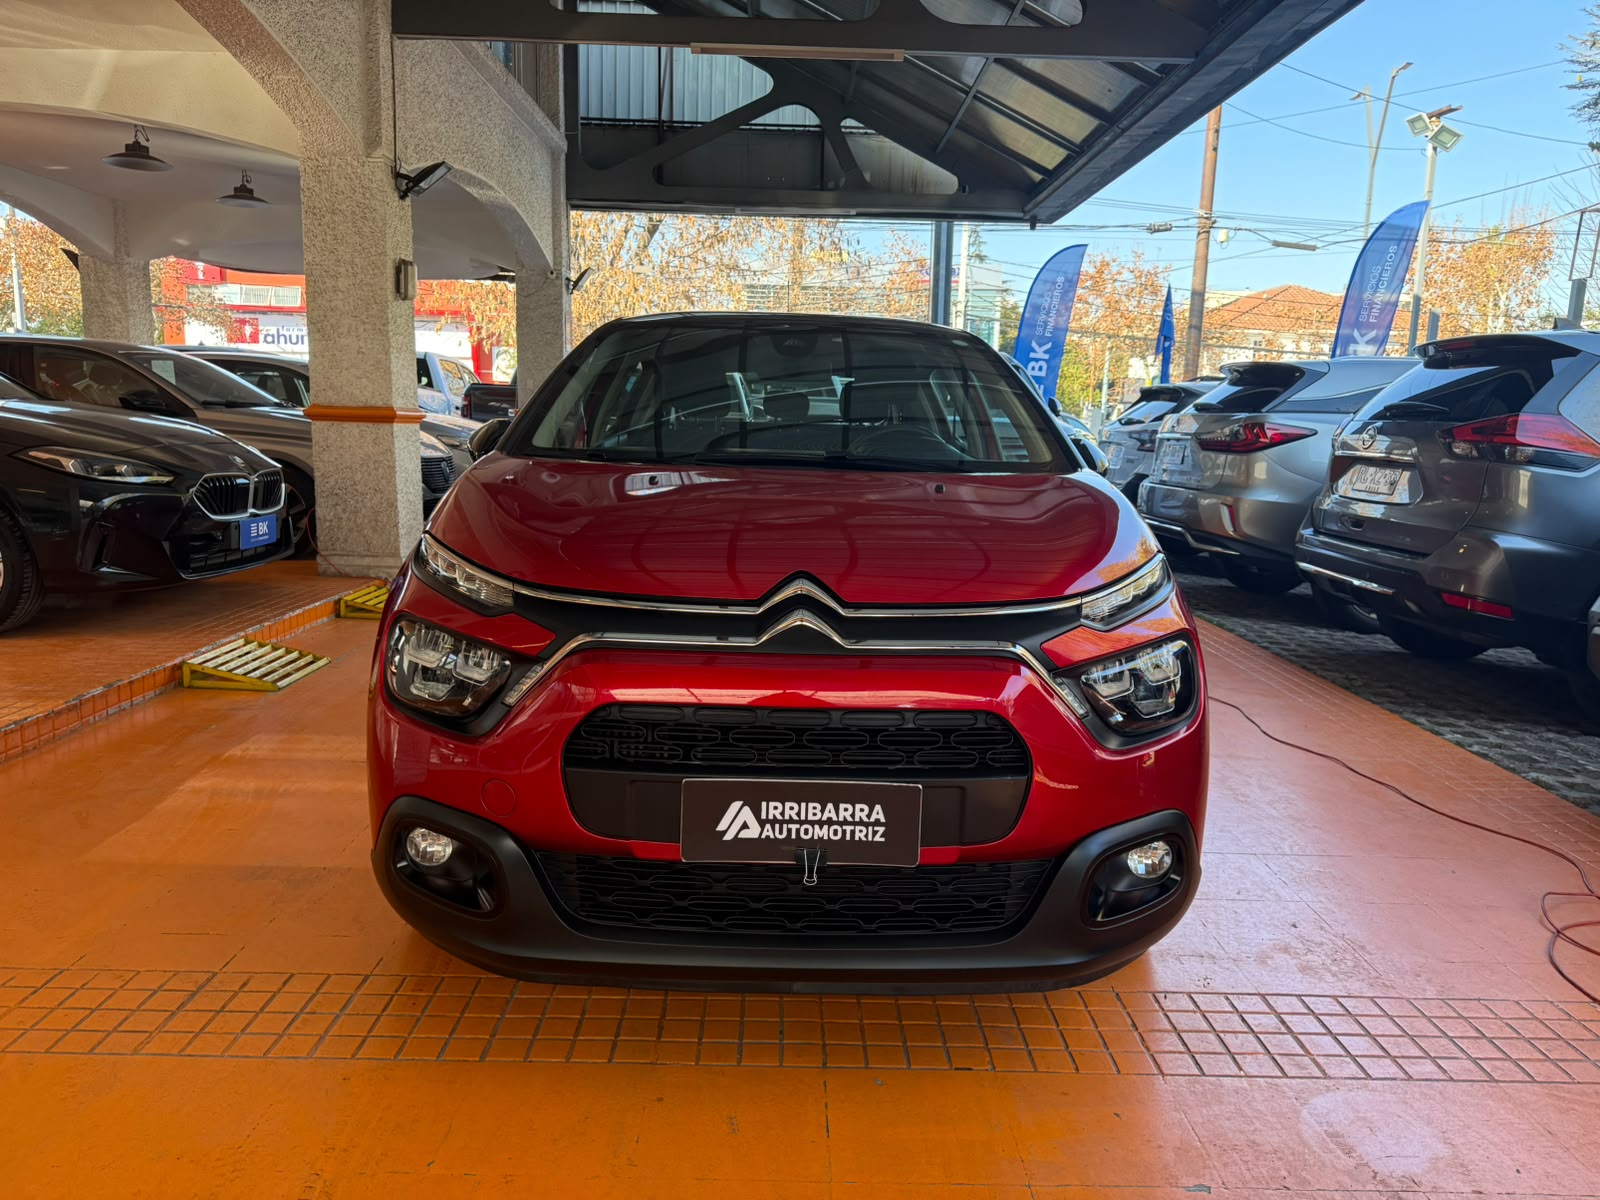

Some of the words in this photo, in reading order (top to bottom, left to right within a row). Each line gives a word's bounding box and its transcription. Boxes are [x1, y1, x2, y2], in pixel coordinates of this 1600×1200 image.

[1359, 265, 1381, 322] SERVICIOS
[1369, 245, 1398, 322] FINANCIEROS
[1035, 291, 1051, 336] SERVICIOS
[1045, 276, 1065, 337] FINANCIEROS
[1026, 340, 1053, 377] BK
[258, 520, 269, 536] BK
[760, 801, 886, 823] IRRIBARRA
[760, 823, 886, 842] AUTOMOTRIZ
